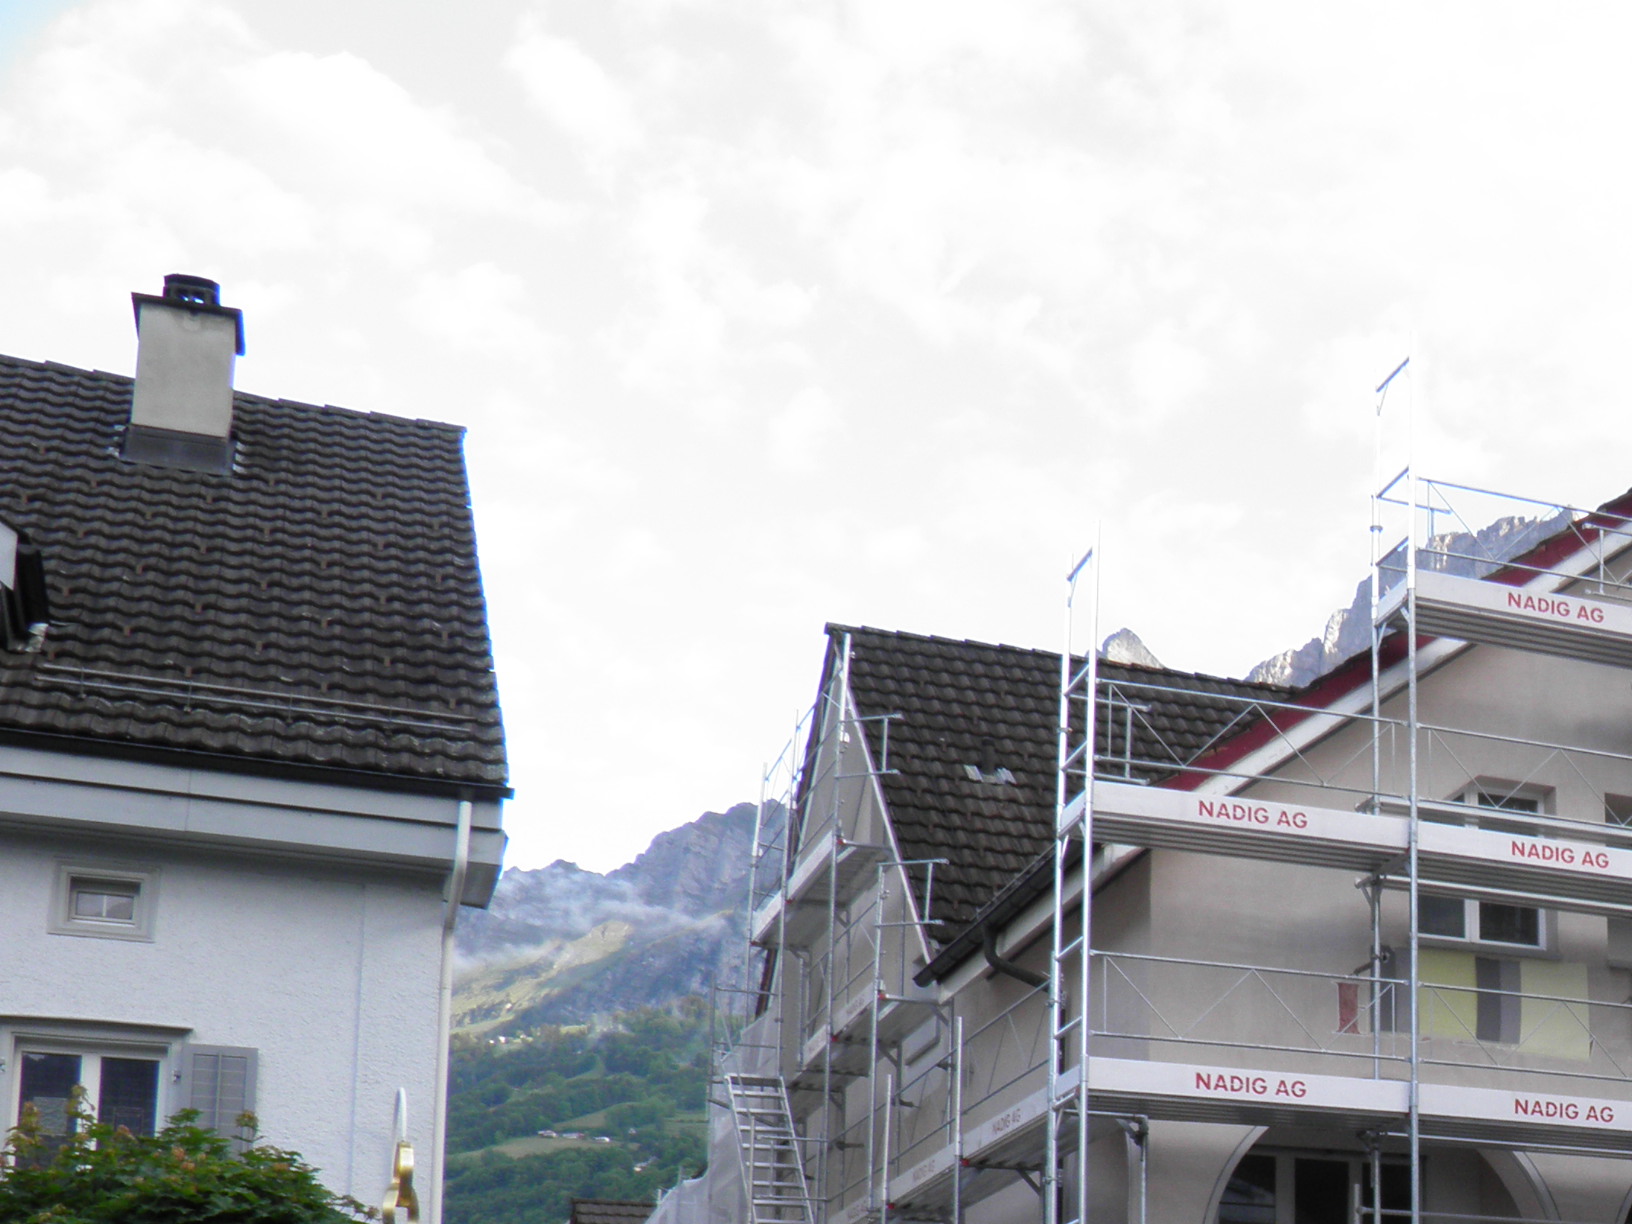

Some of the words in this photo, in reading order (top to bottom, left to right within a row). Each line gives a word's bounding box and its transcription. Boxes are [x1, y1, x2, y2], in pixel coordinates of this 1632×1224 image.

[1507, 592, 1570, 617] NADIG
[1577, 605, 1604, 623] AG
[1198, 800, 1268, 825] NADIG
[1277, 811, 1308, 830] AG
[1510, 841, 1575, 865] NADIG
[1582, 852, 1610, 870] AG
[1195, 1072, 1267, 1096] NADIG
[1275, 1081, 1307, 1098] AG
[1514, 1099, 1579, 1121] NADIG
[1586, 1106, 1615, 1123] AG
